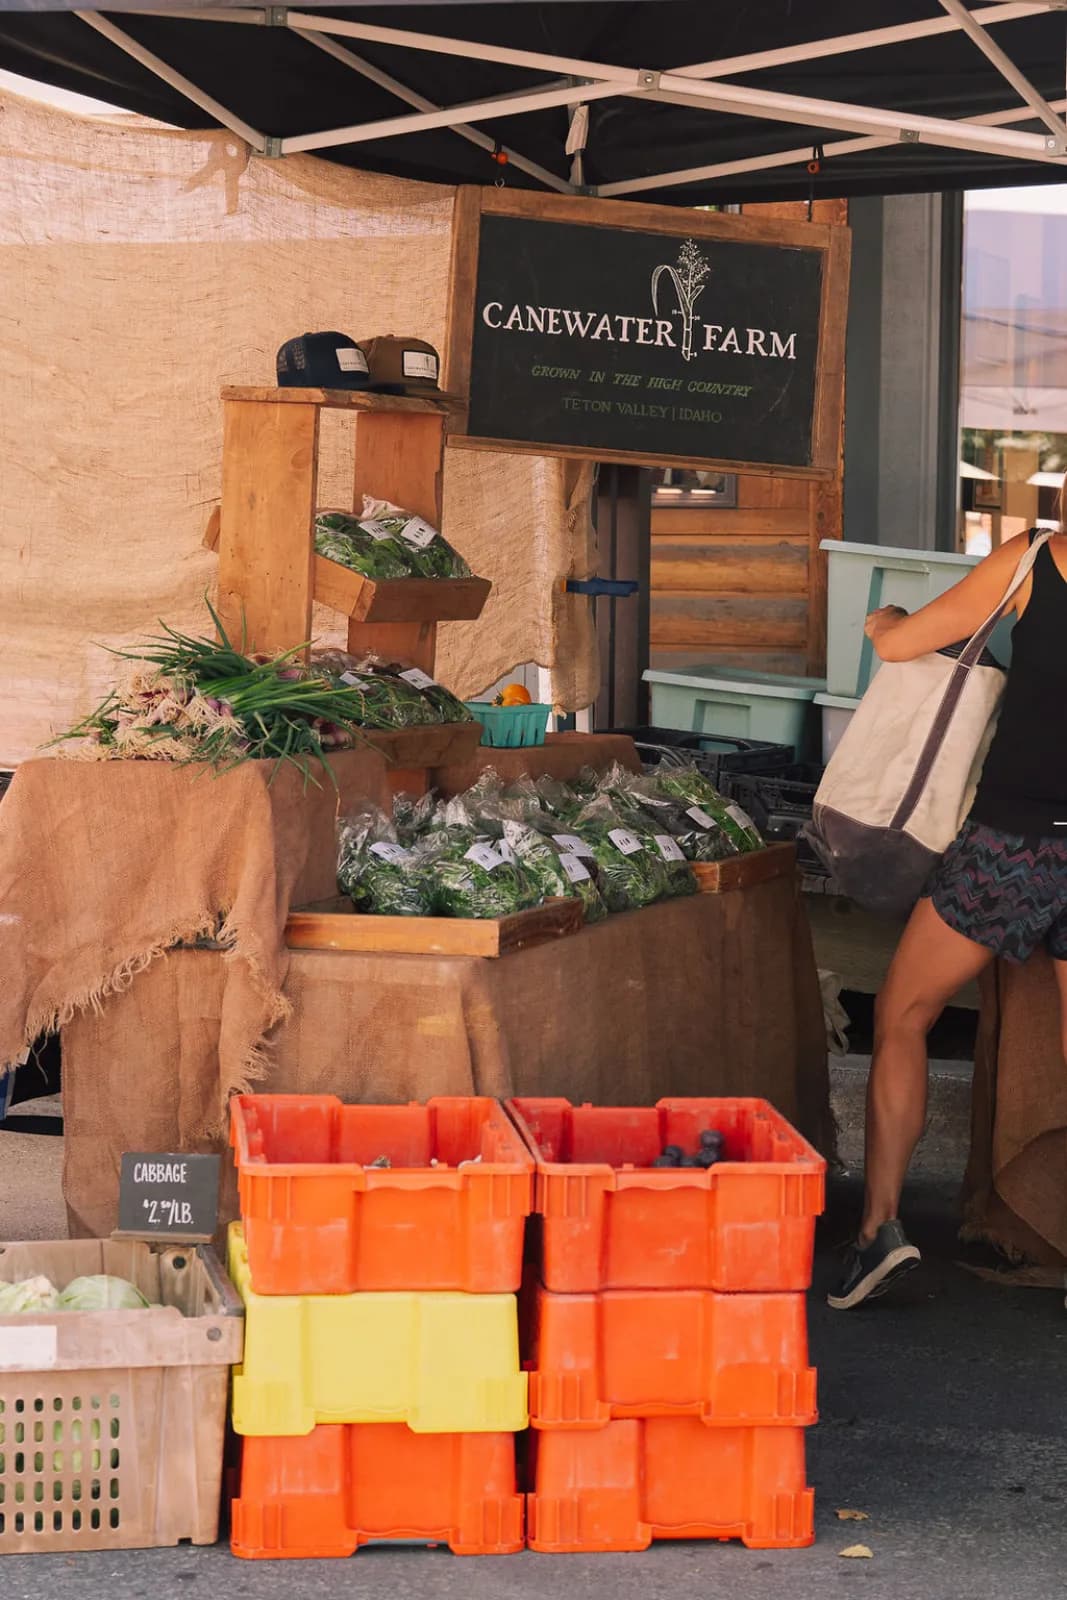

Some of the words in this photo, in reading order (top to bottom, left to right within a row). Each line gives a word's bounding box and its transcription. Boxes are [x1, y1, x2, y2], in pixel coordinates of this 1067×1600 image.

[482, 301, 677, 348] CANEWATER
[702, 324, 797, 360] FARM
[531, 365, 581, 380] GROWN
[589, 371, 606, 383] IN
[613, 373, 642, 387] THE
[647, 377, 684, 392] HIGH
[687, 380, 753, 397] COUNTRY
[561, 397, 612, 413] TETON
[616, 402, 670, 418] VALLEY
[679, 407, 723, 424] IDAHO
[133, 1162, 188, 1184] CABBAGE
